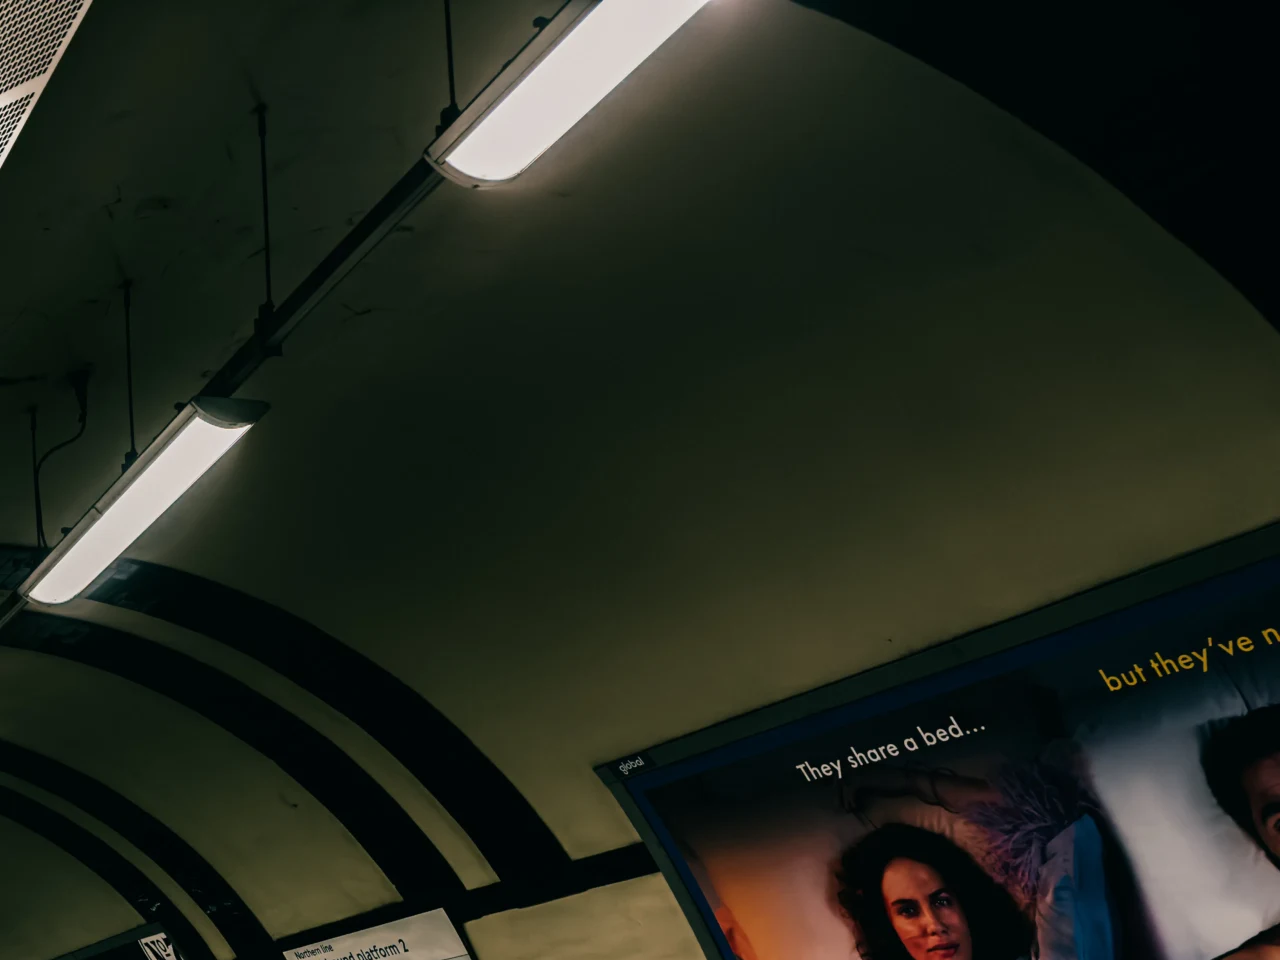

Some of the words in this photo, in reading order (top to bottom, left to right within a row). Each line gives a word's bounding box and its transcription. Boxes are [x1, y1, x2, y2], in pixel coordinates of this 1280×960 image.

[1098, 663, 1146, 691] but
[1149, 636, 1255, 673] they've
[796, 757, 843, 781] They
[847, 743, 900, 769] share
[904, 737, 919, 752] a
[916, 715, 986, 747] bed...
[618, 757, 645, 775] global
[294, 945, 320, 960] Northern
[320, 943, 334, 955] line
[398, 939, 409, 953] 2
